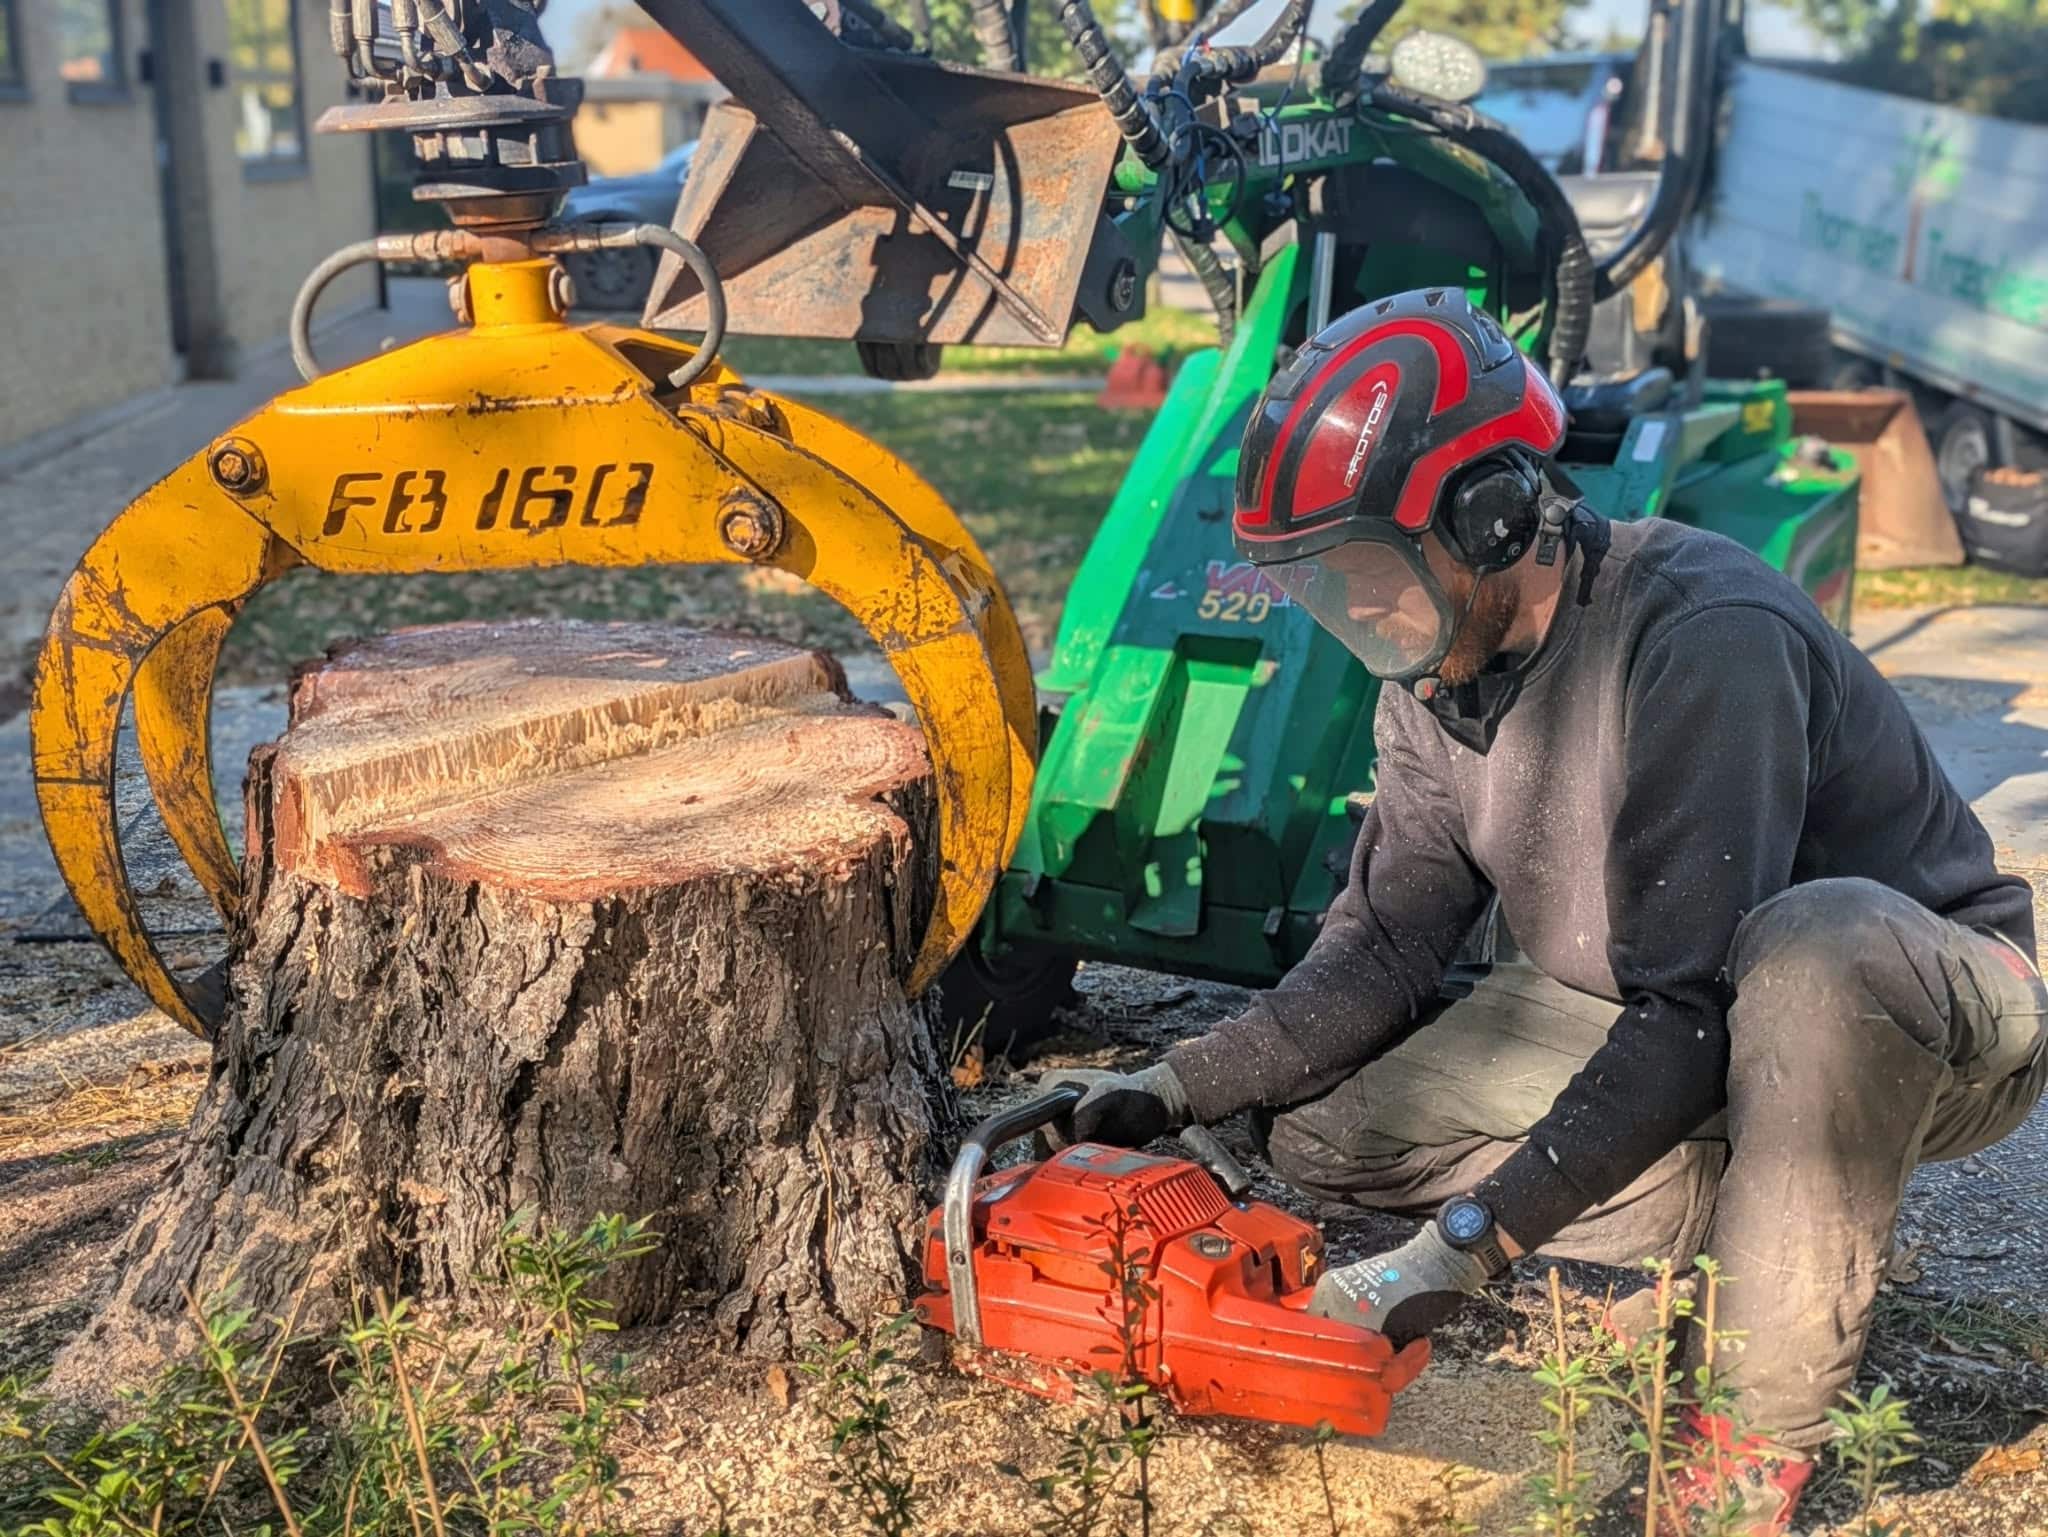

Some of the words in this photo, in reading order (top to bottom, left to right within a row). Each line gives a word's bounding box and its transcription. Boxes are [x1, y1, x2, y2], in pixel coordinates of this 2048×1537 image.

[1258, 118, 1355, 166] ILDKAT
[1344, 391, 1388, 488] PROTOS
[322, 470, 448, 536] FB
[475, 462, 655, 531] 160
